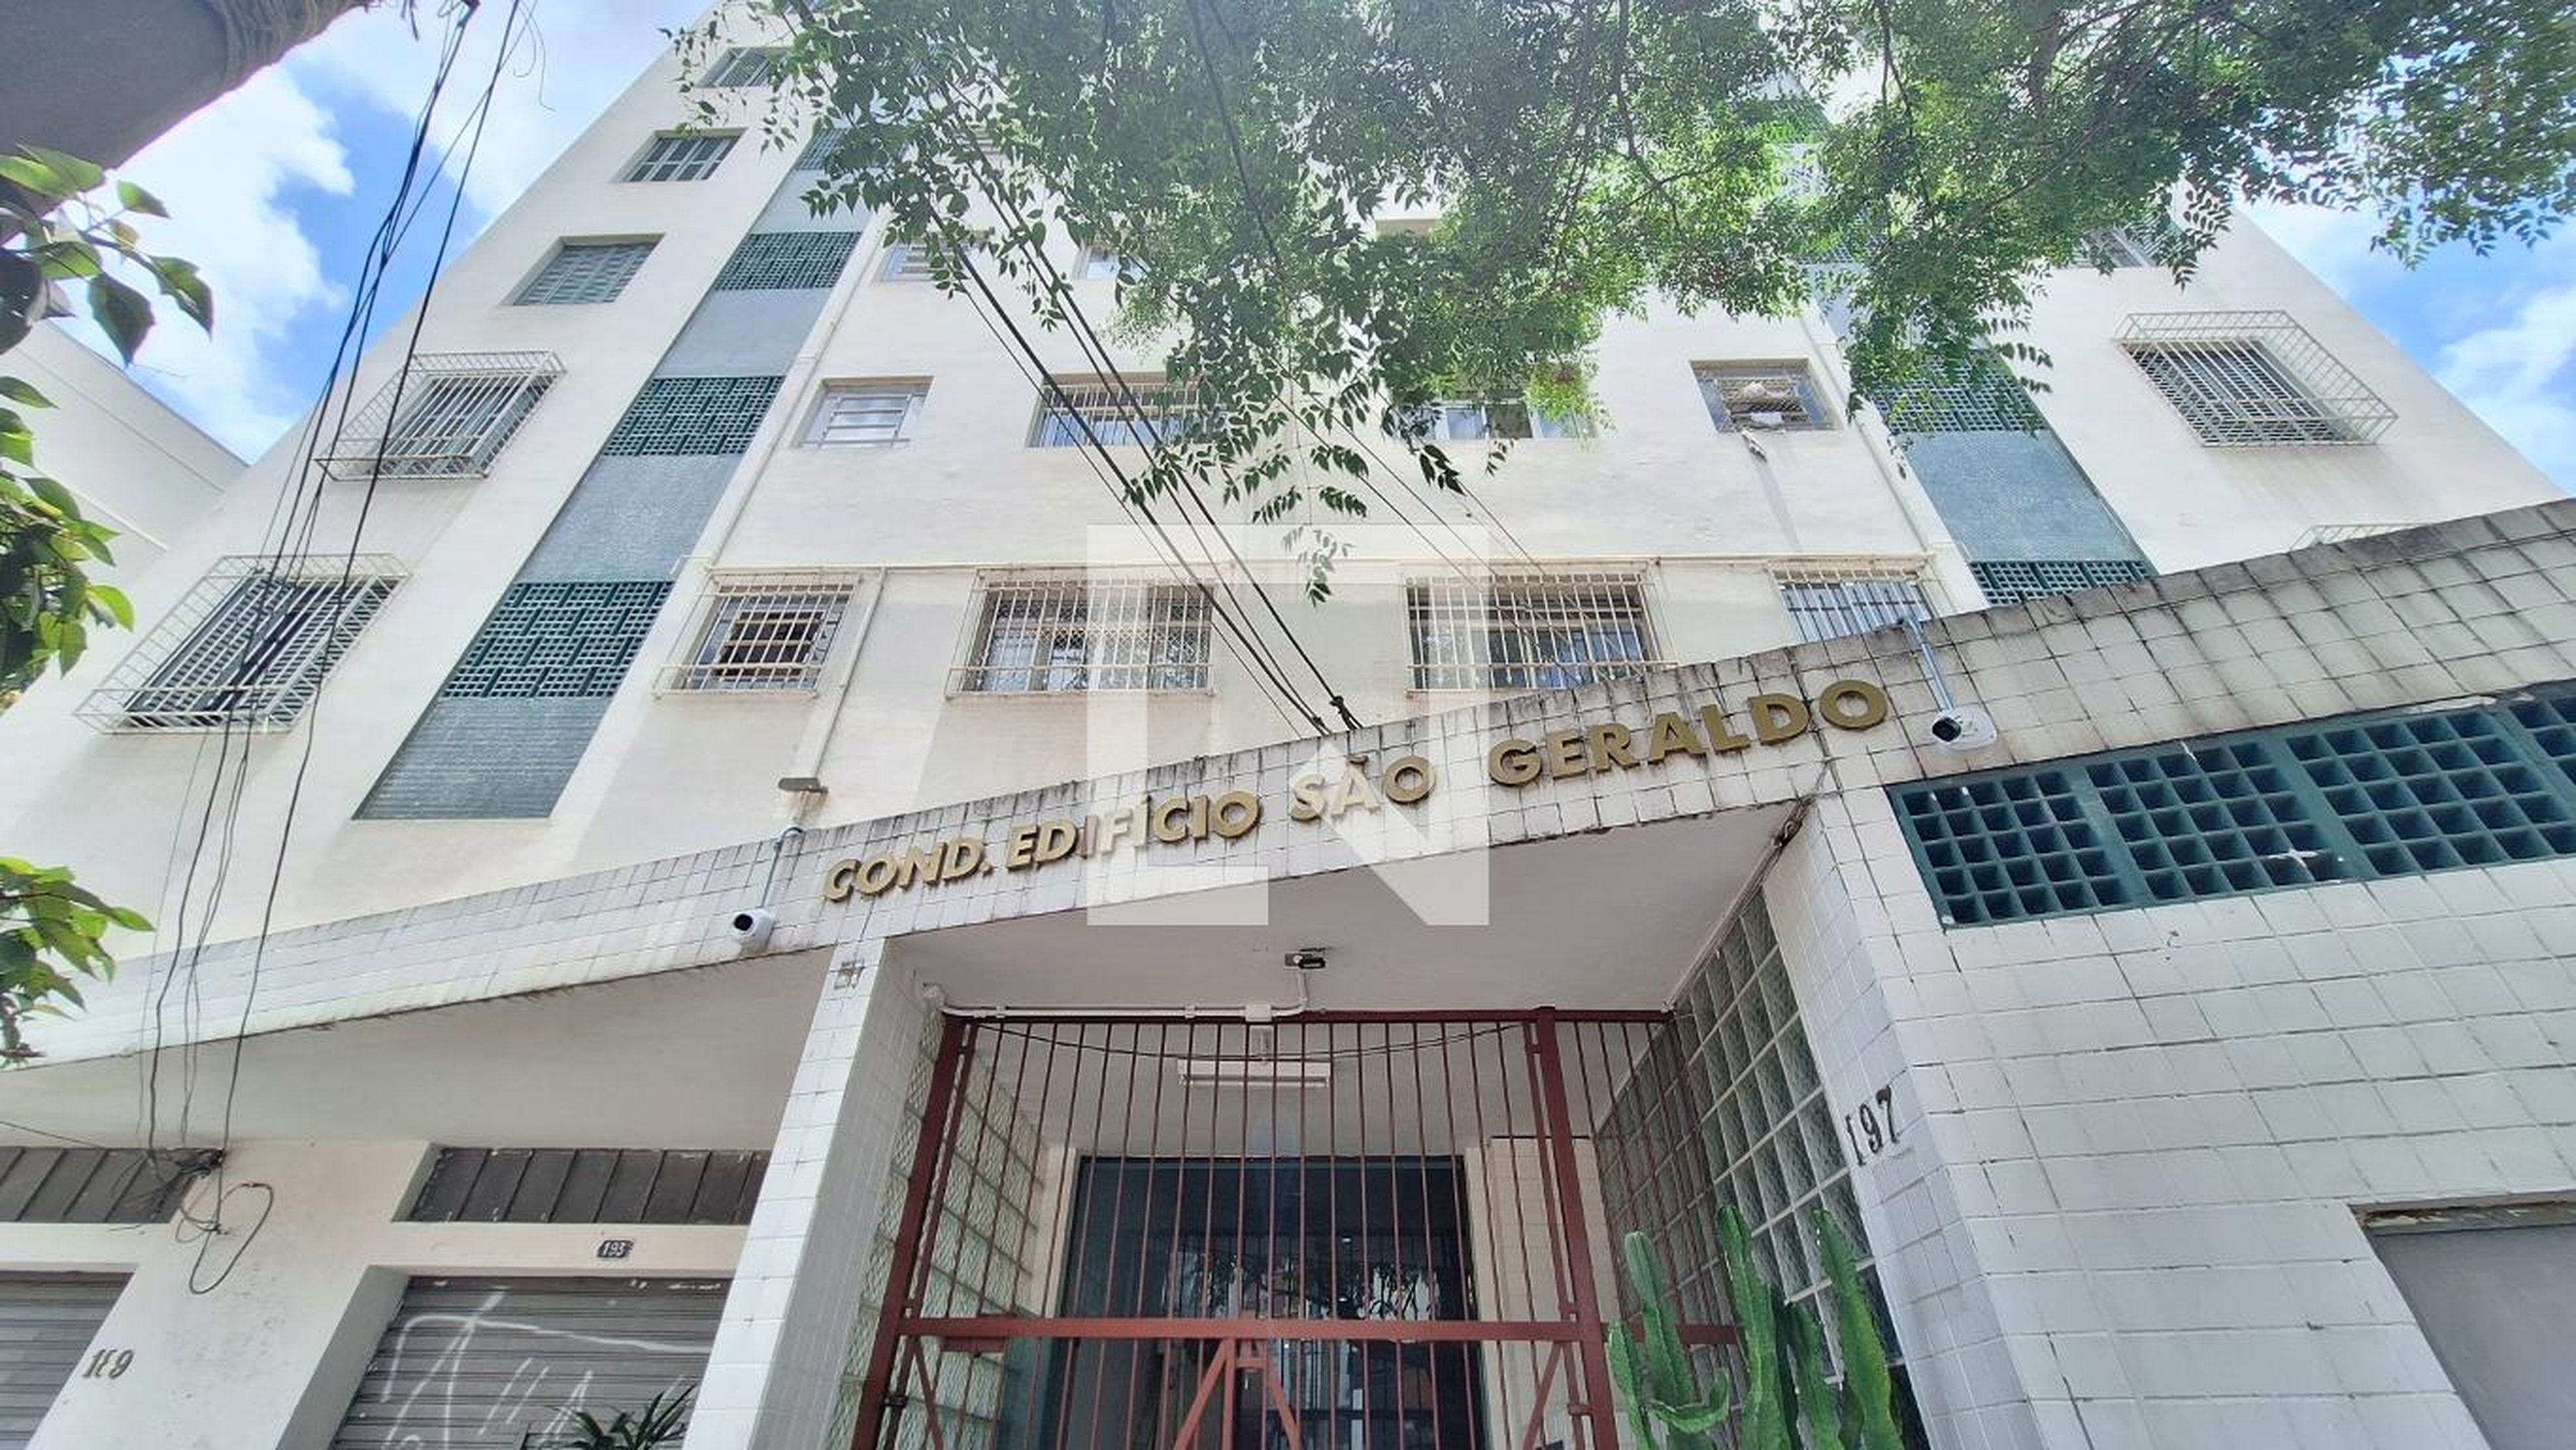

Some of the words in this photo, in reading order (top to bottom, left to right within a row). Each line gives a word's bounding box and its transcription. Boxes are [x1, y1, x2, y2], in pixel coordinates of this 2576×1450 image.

[824, 835, 994, 902] COND.
[1006, 790, 1263, 872] EDIFÍCIO
[1289, 754, 1436, 823] SÃO
[1488, 679, 1889, 787] GERALDO
[1845, 1084, 1900, 1166] 197
